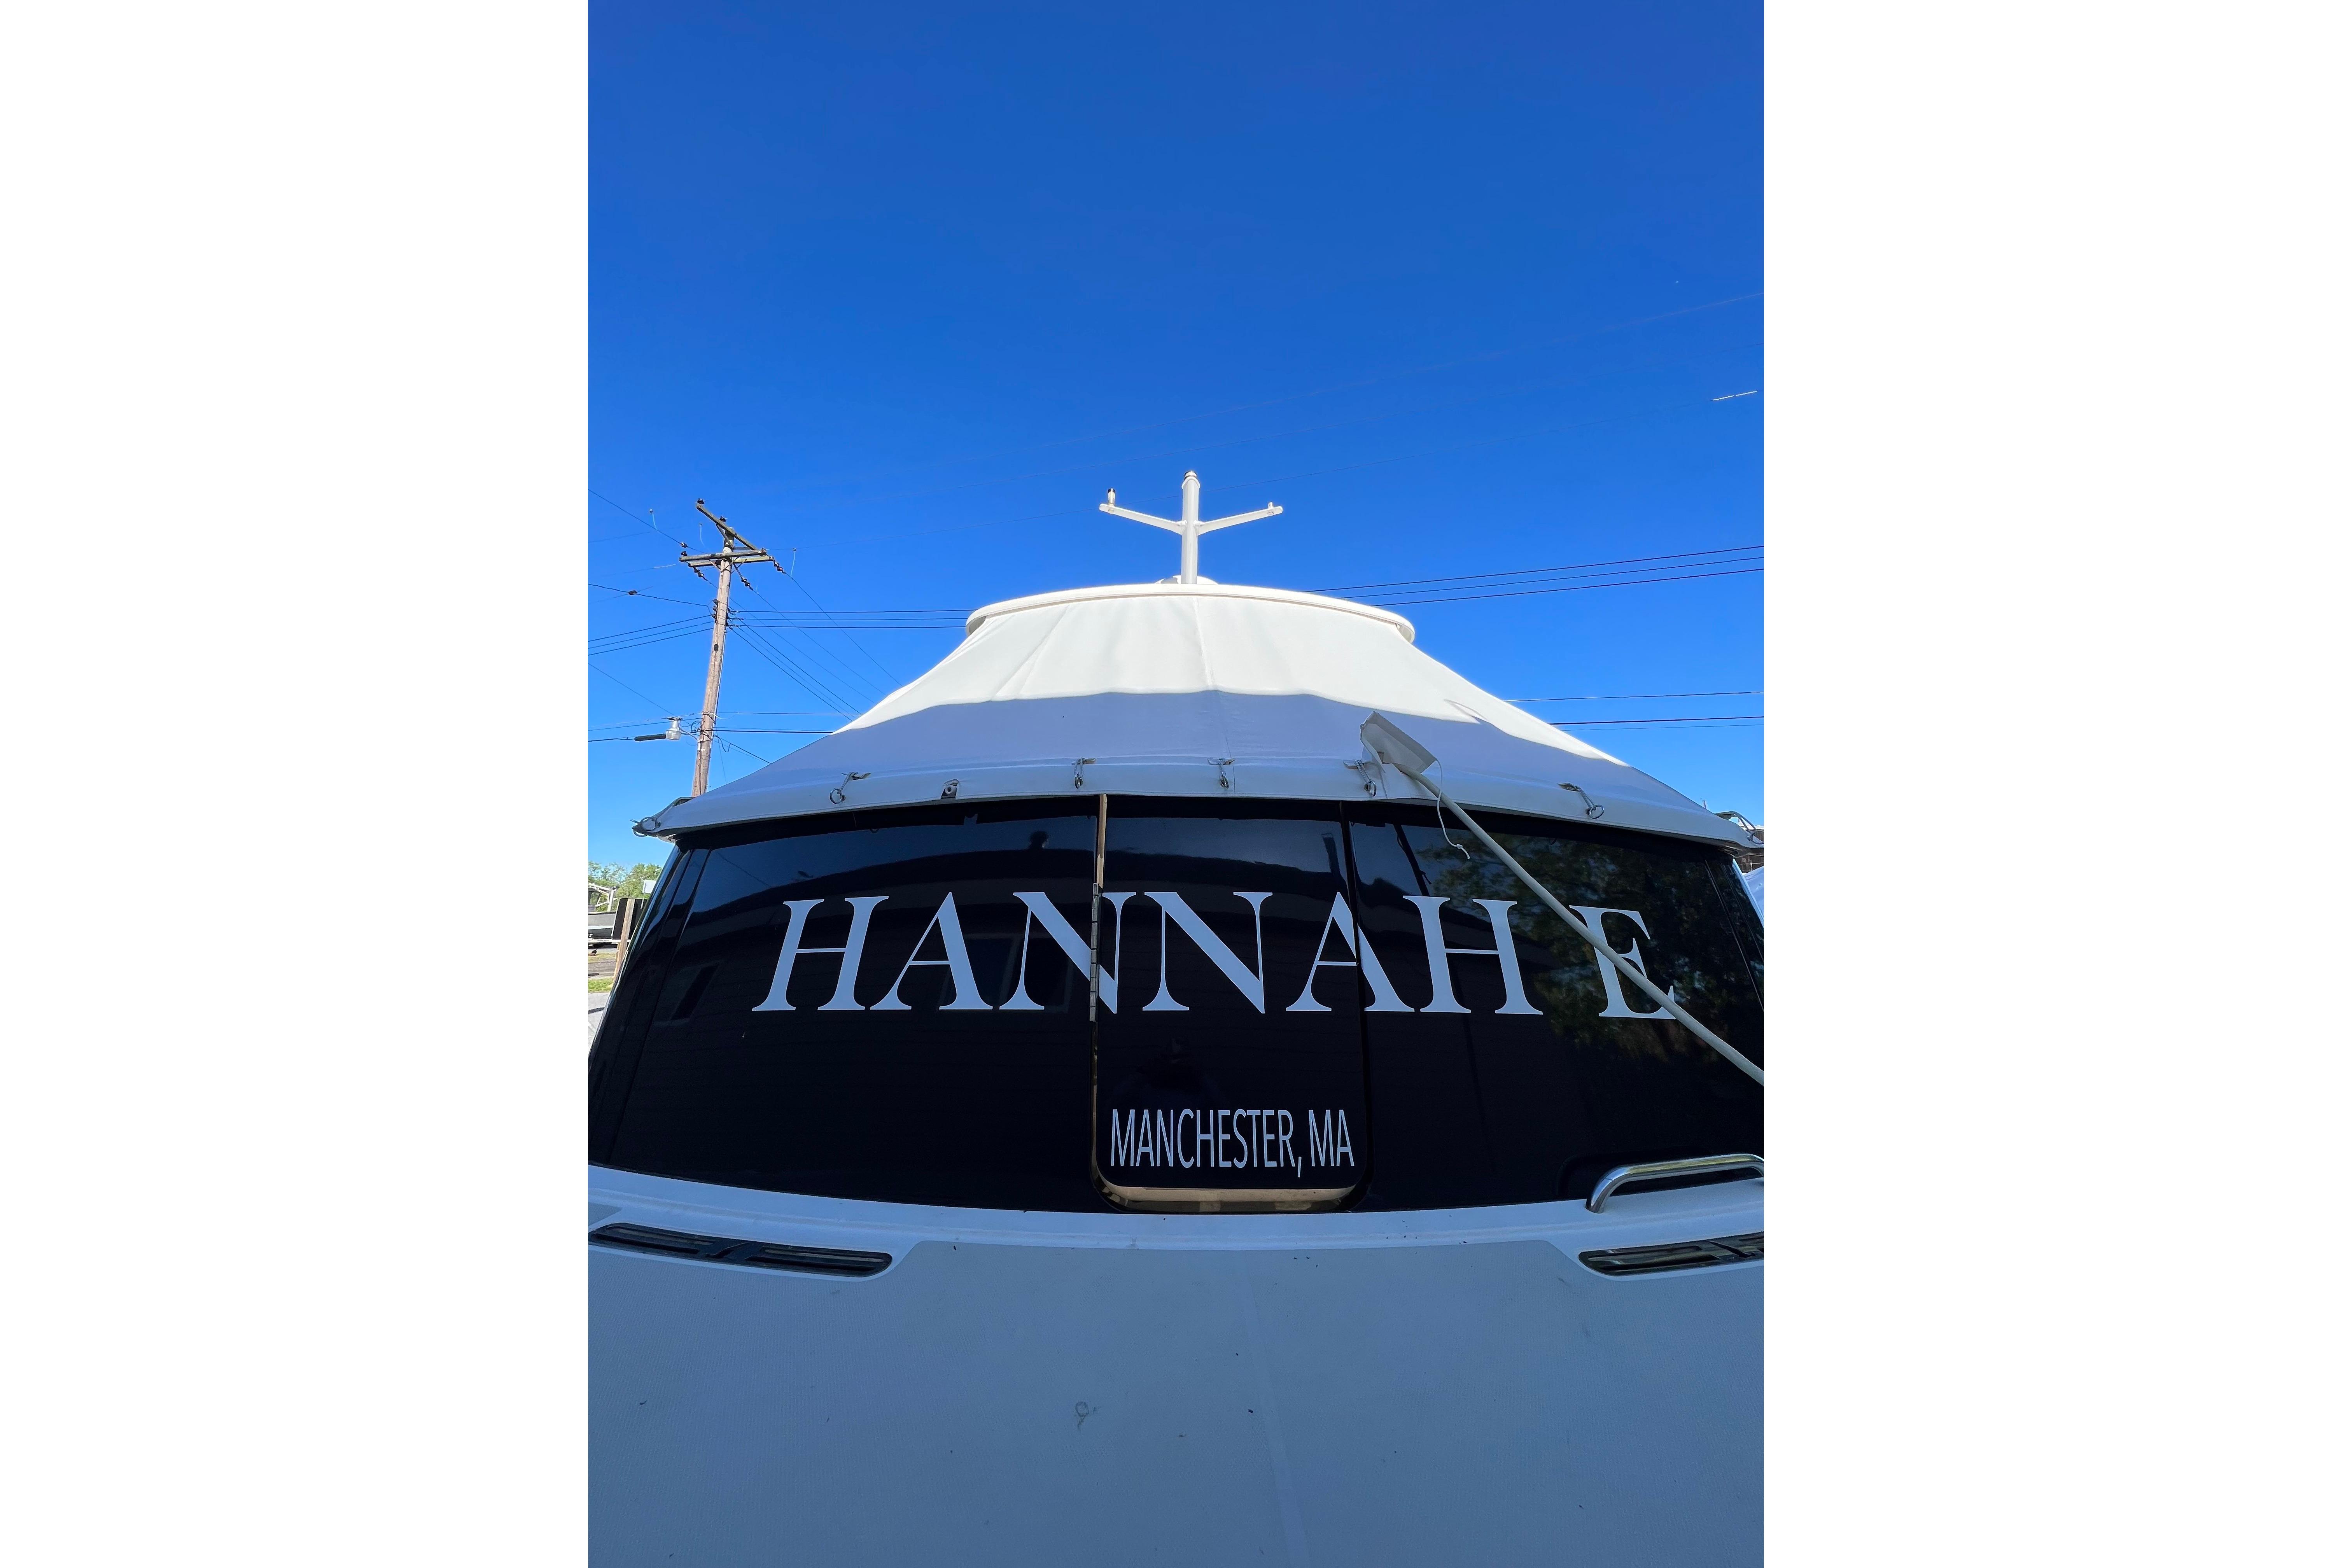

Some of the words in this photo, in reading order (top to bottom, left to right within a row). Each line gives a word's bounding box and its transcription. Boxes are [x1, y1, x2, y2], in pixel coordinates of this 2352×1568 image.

[751, 891, 1543, 1015] HANNAH
[1568, 905, 1676, 1020] E
[1111, 1108, 1302, 1178] MANCHESTER,
[1308, 1109, 1355, 1167] MA
